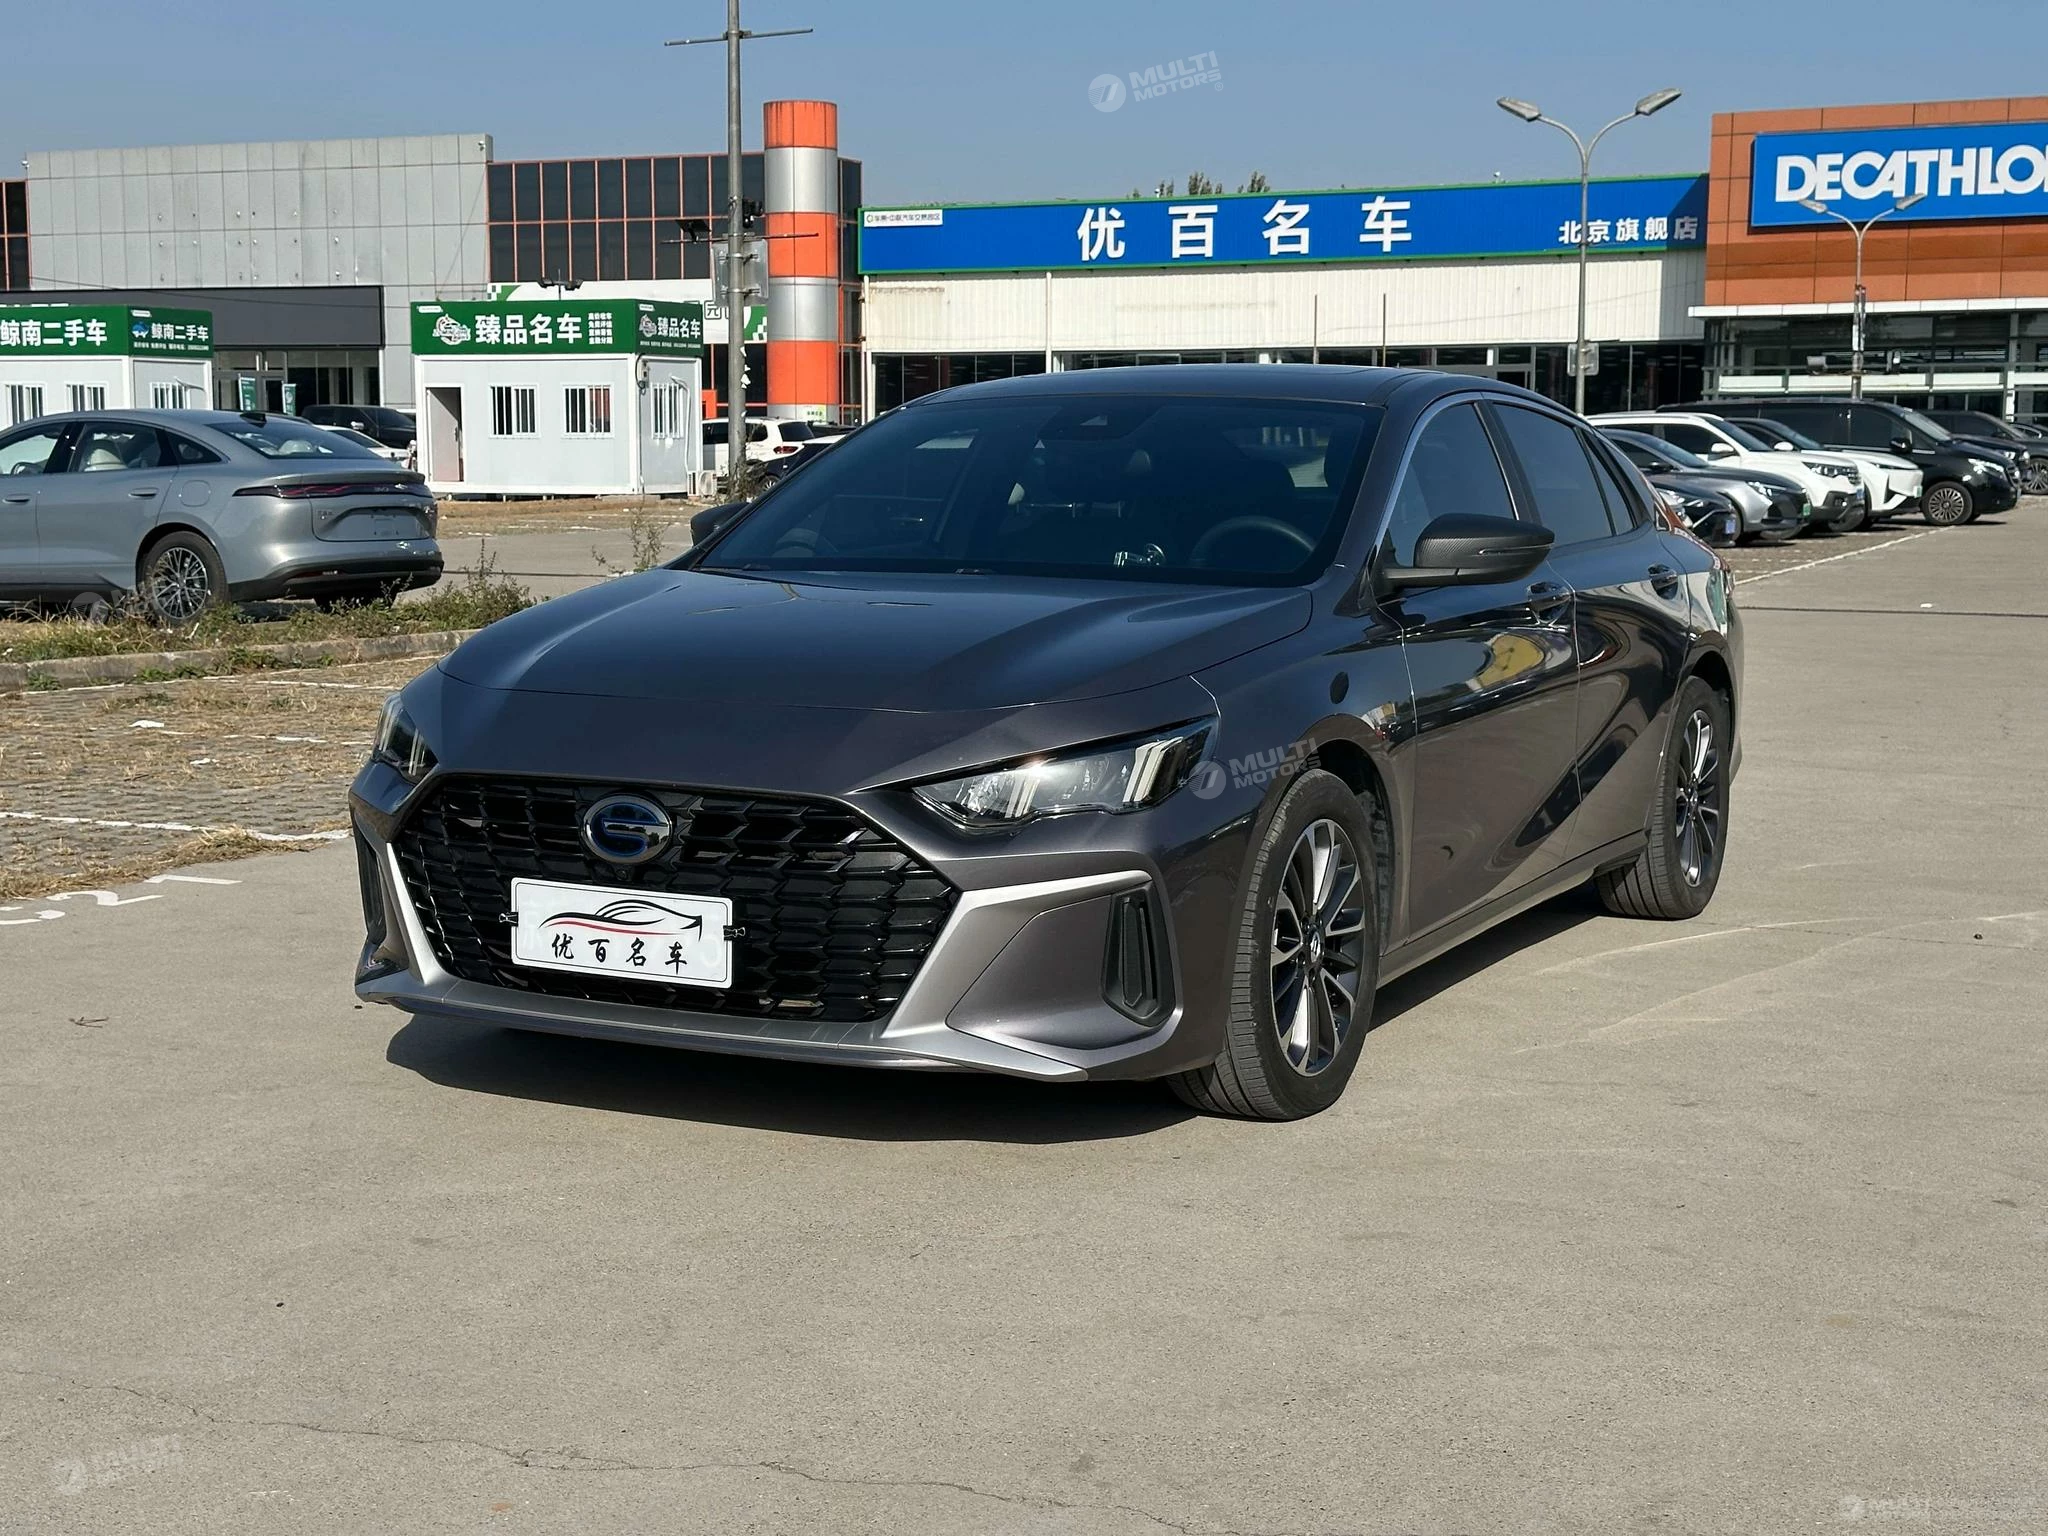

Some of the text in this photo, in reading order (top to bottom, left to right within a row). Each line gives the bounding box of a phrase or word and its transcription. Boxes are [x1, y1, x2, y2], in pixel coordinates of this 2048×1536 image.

[1775, 144, 2048, 203] DECATHLO
[1077, 196, 1412, 262] 优百名车
[1558, 215, 1699, 244] 北京旗舰店
[0, 318, 108, 347] 鲸南二手车
[150, 322, 209, 342] 鲸南二手车
[475, 312, 582, 345] 臻品名车
[657, 316, 701, 339] 臻品名车
[551, 932, 688, 975] 优百名车
